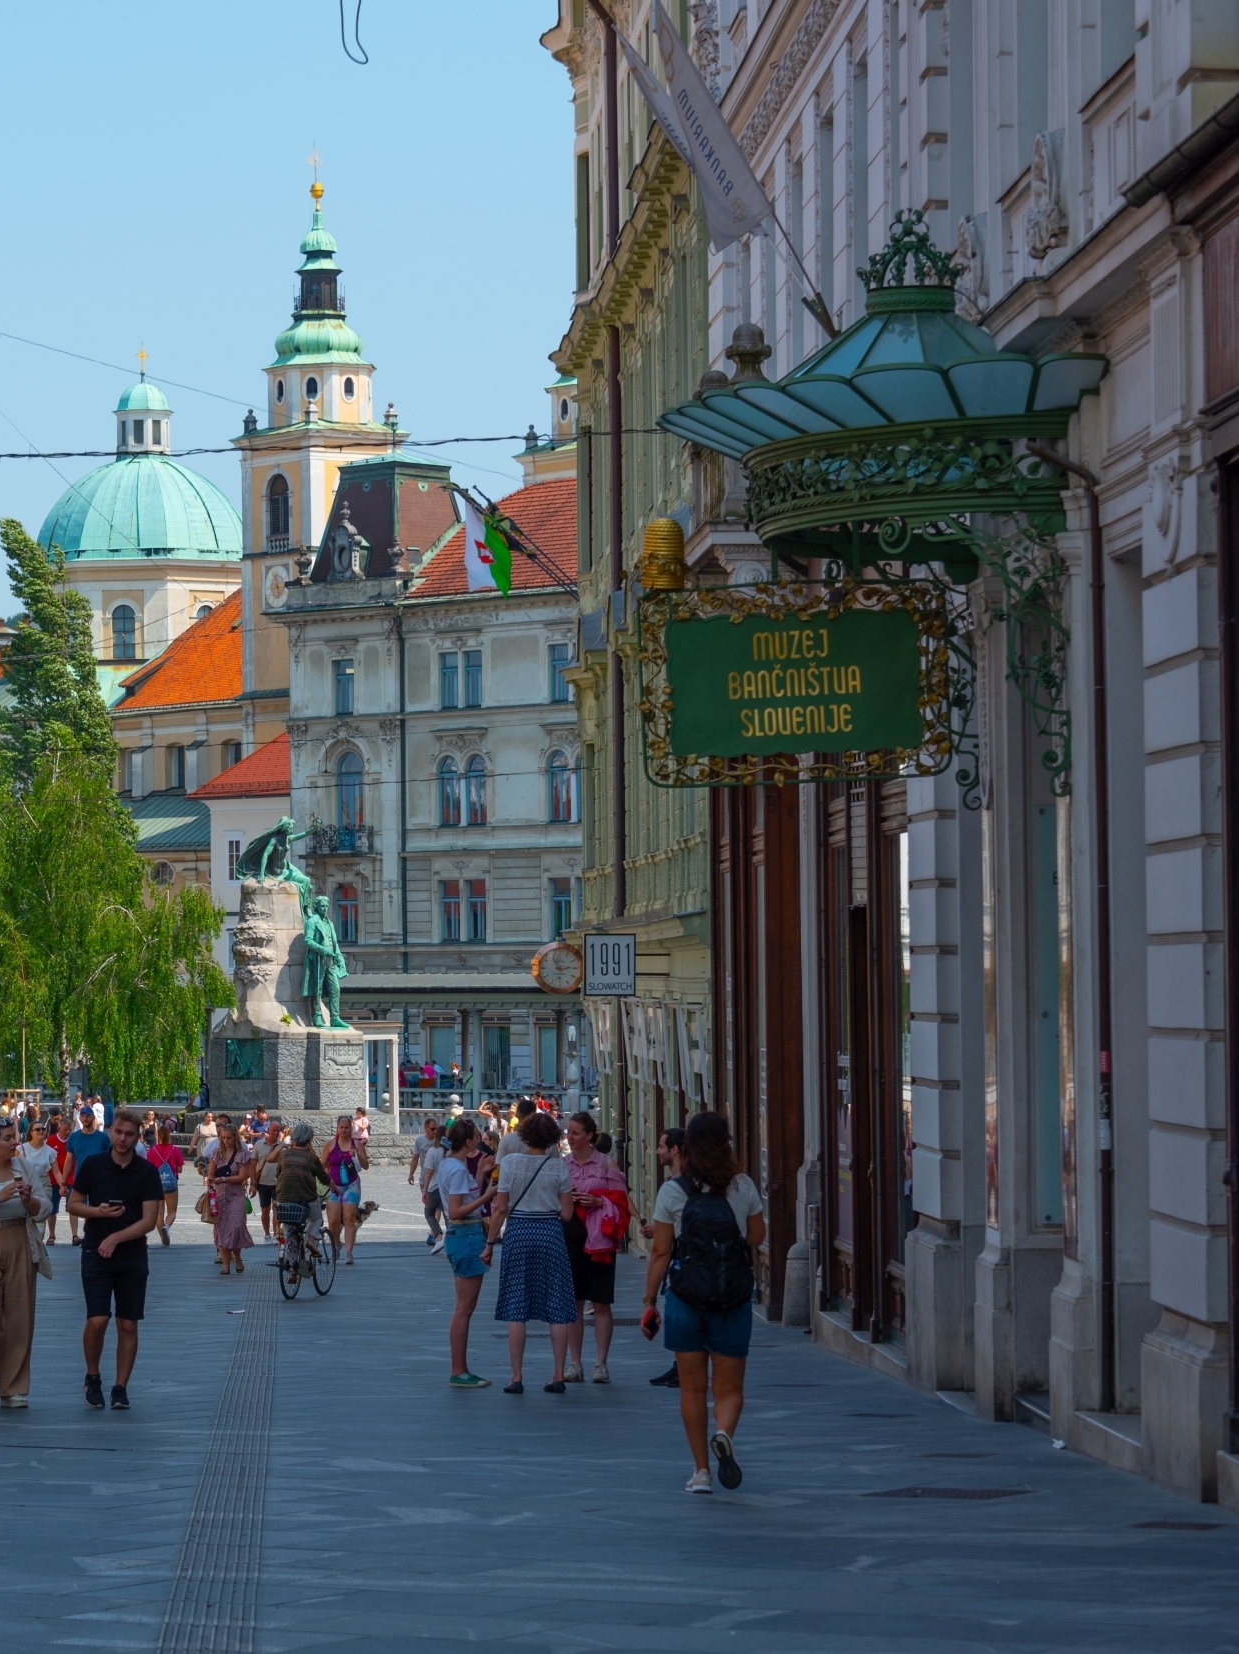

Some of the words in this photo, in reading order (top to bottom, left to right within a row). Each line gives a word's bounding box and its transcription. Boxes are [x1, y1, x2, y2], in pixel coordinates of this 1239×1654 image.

[753, 629, 828, 661] MUZEJ
[727, 662, 861, 700] BANČNIŠTVA
[740, 703, 852, 737] SLOVENIJE
[589, 942, 630, 976] 1991
[588, 982, 633, 991] SLOWATCH
